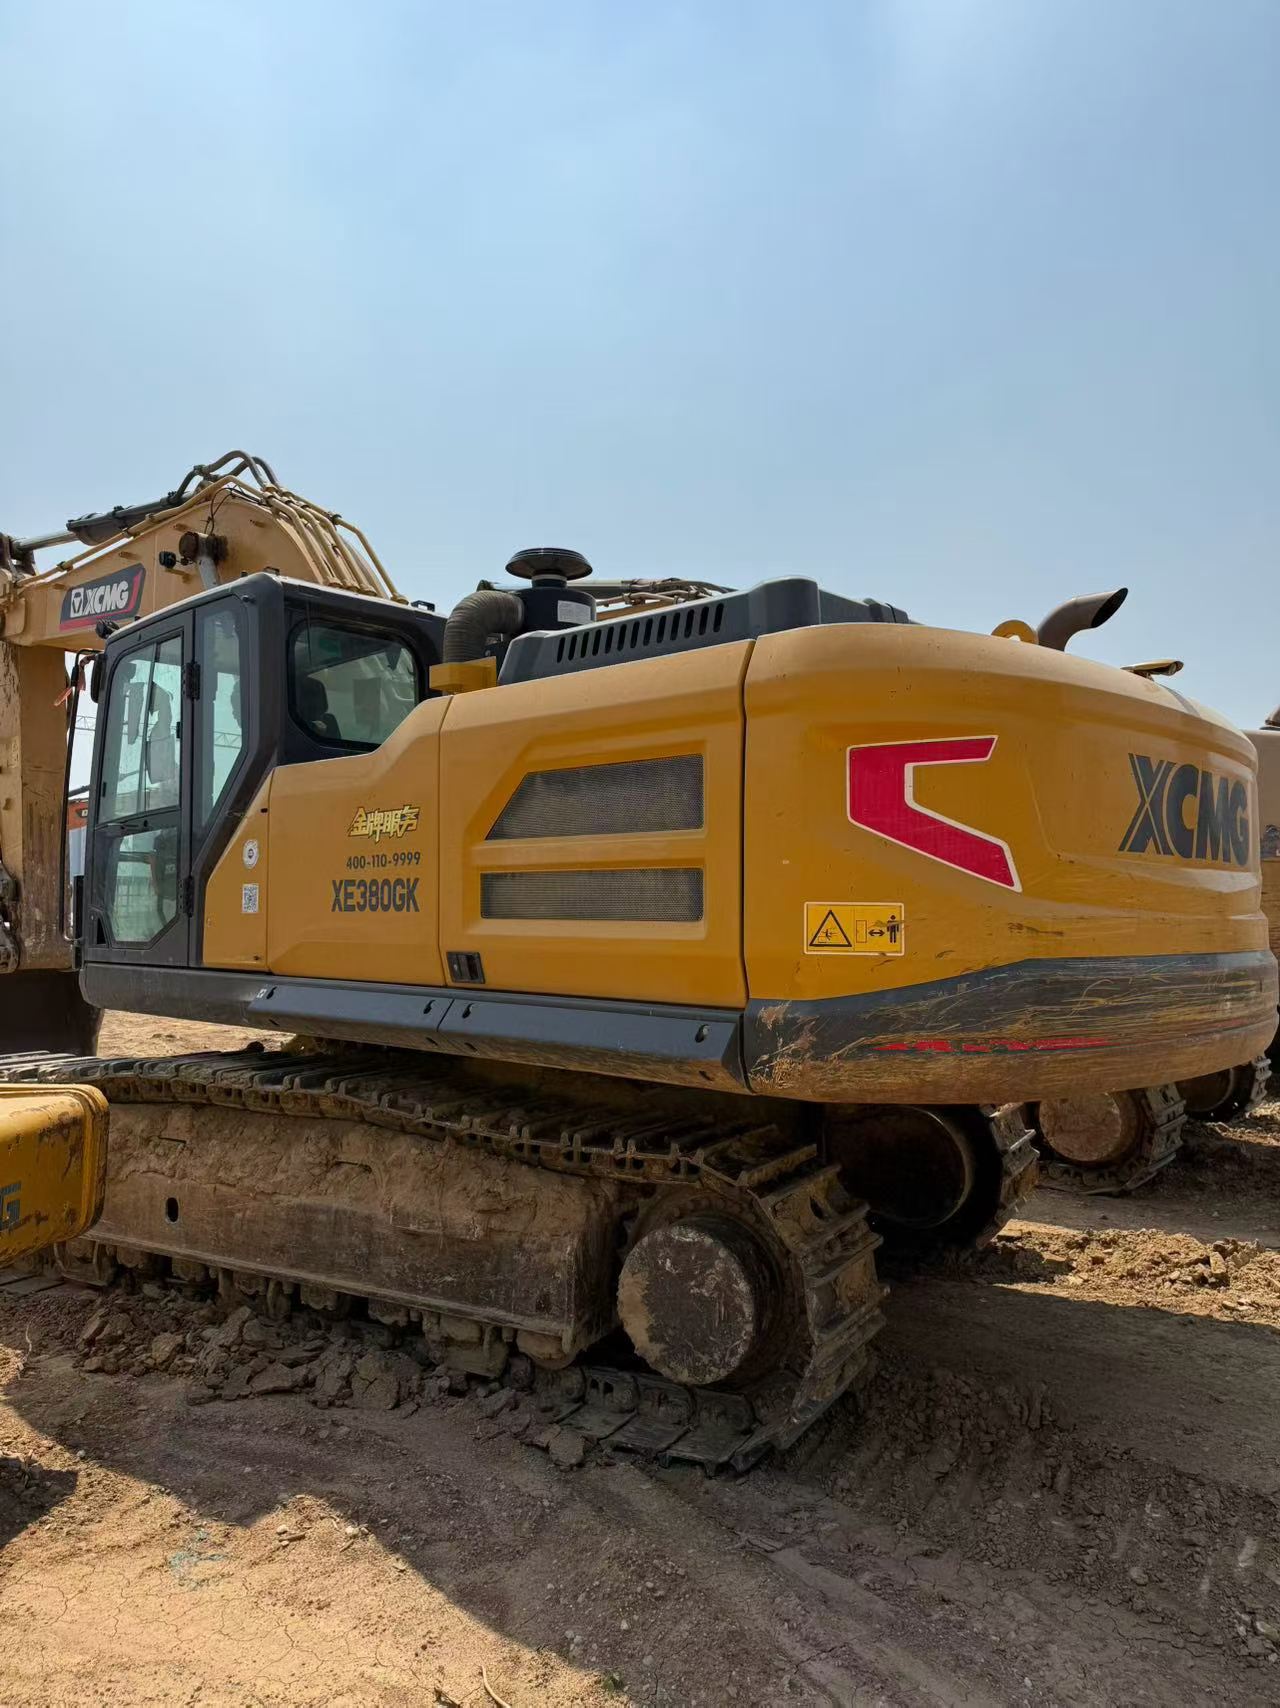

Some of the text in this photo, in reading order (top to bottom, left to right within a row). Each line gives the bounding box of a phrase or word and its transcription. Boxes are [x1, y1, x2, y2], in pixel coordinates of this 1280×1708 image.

[83, 580, 129, 615] XCMG
[347, 805, 420, 843] 金牌服务
[1118, 753, 1249, 867] XCMG
[346, 851, 421, 869] 400-110-9999
[331, 878, 420, 912] XE380GK
